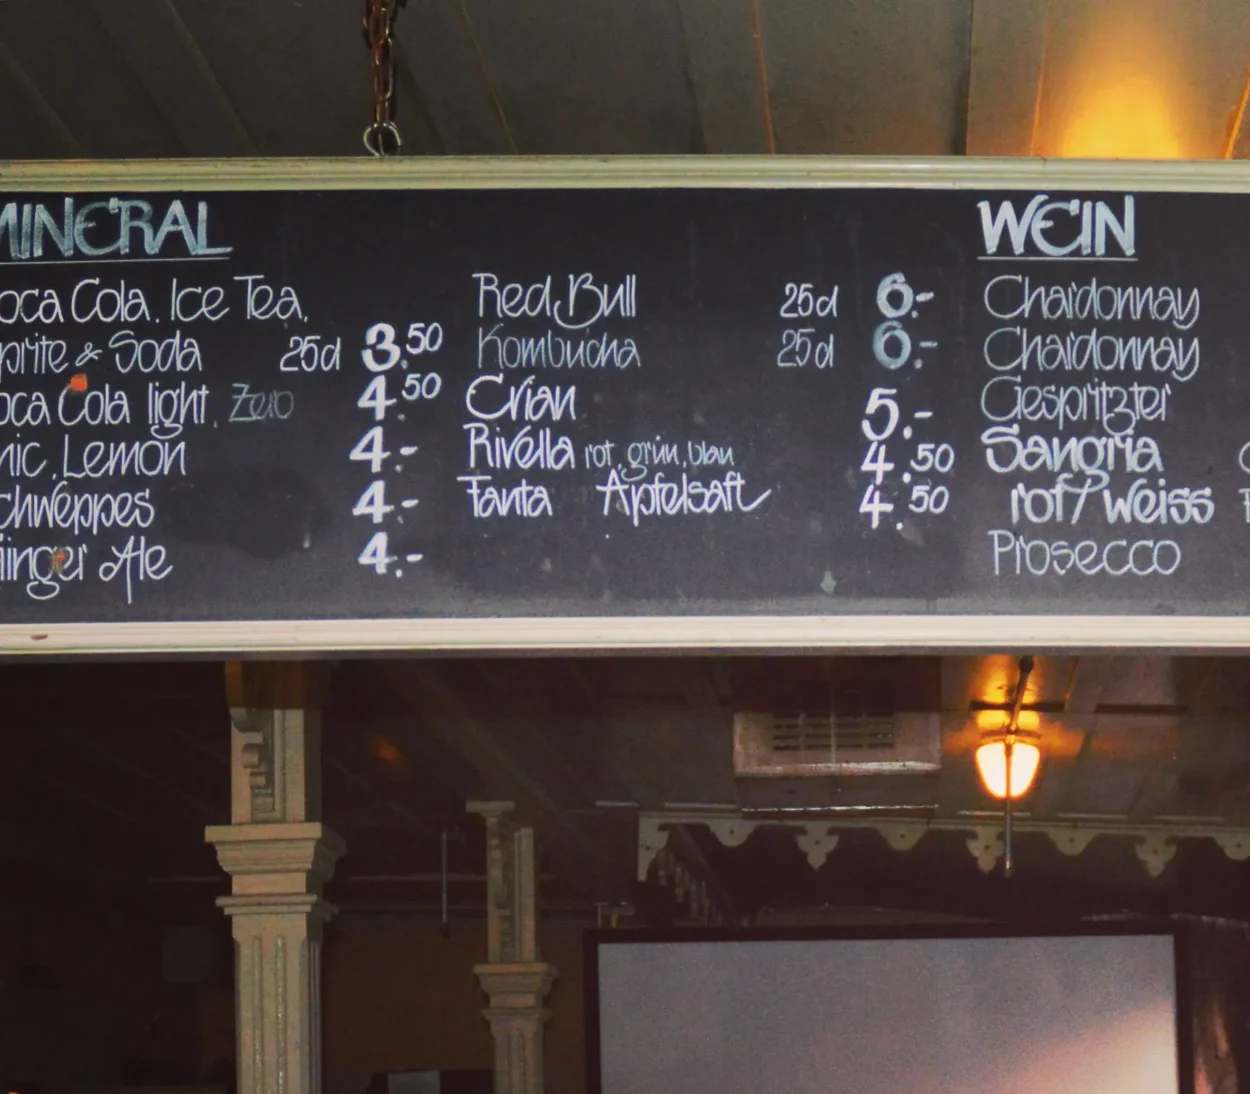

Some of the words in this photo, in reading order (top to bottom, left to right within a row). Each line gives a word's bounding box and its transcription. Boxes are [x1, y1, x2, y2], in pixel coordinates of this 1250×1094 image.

[977, 195, 1136, 257] WEIN
[171, 278, 229, 322] Ice
[471, 272, 552, 319] Red
[554, 272, 637, 329] Bull
[983, 274, 1200, 329] Chardonnay
[109, 330, 203, 374] Soda
[478, 322, 642, 370] Kombucha
[983, 327, 1200, 381] Chardonnay
[58, 382, 131, 427] Cola
[228, 382, 294, 422] Zero
[62, 434, 187, 479] Lemon
[463, 423, 575, 471] Rivella
[981, 424, 1165, 493] Sangria
[457, 476, 554, 519] Fanta
[596, 466, 772, 527] Apfelsaft
[0, 532, 89, 600] inger
[99, 535, 173, 604] Ale
[986, 530, 1182, 576] Prosecco
